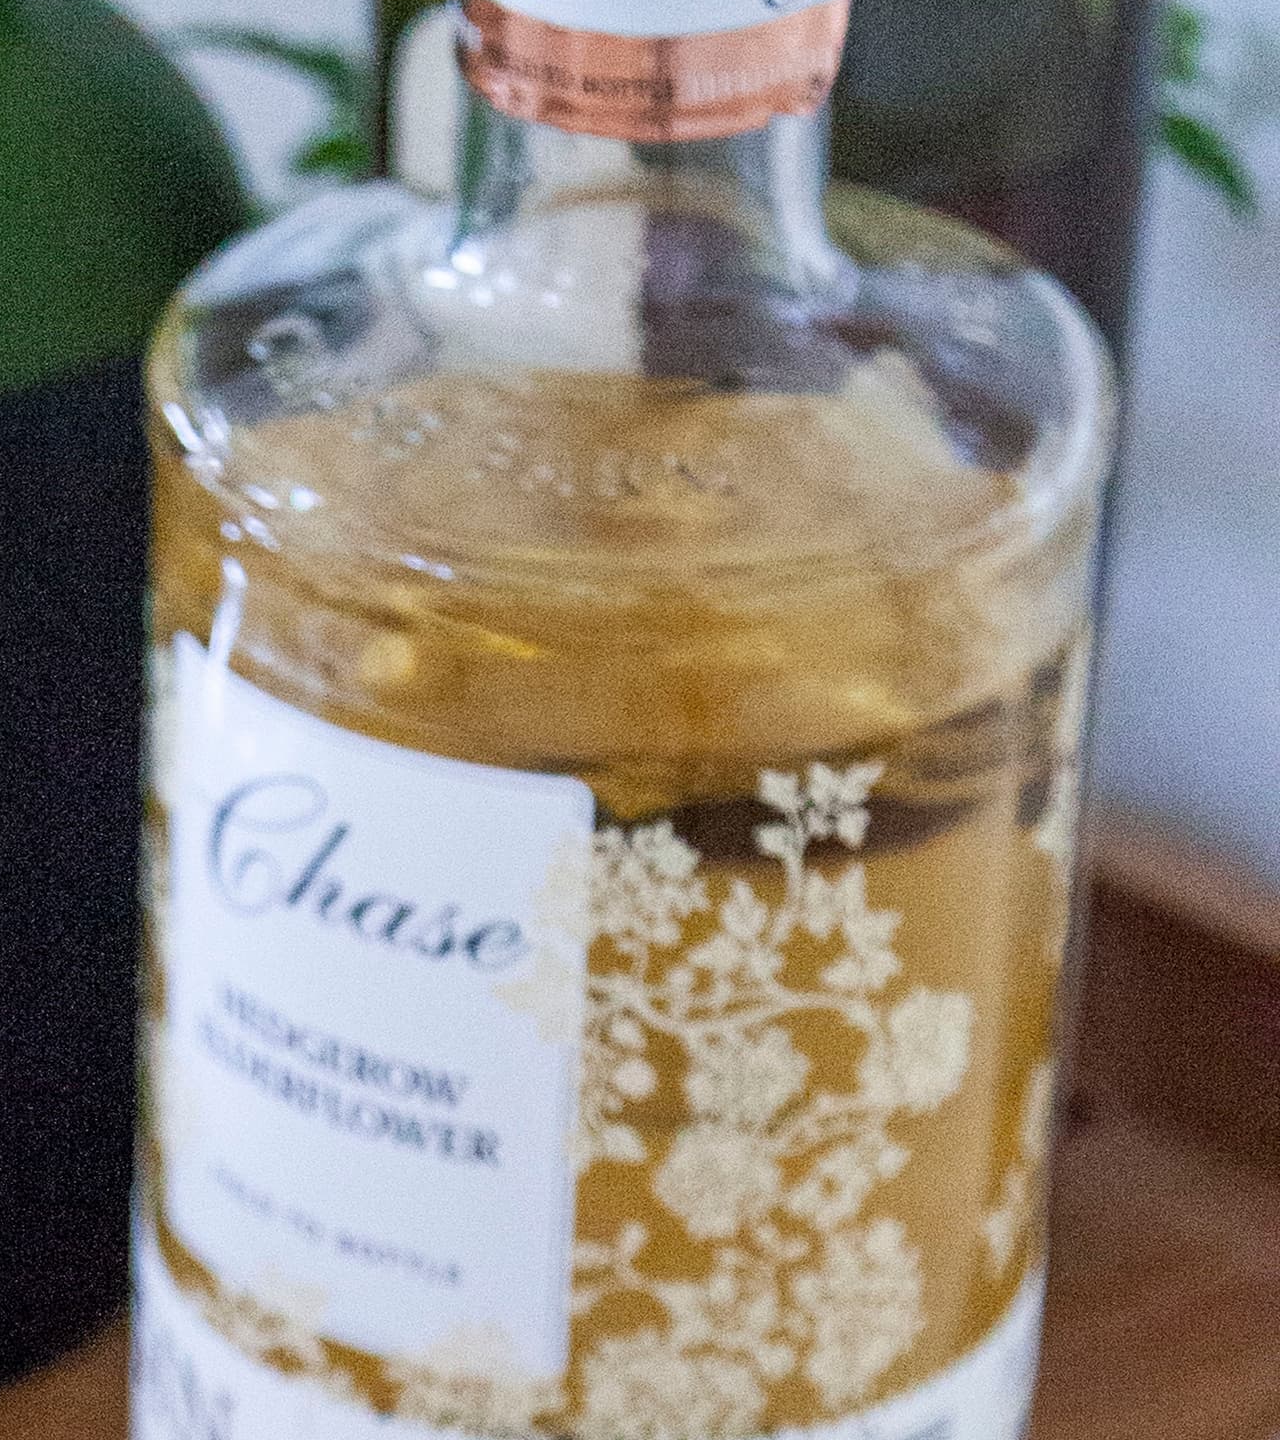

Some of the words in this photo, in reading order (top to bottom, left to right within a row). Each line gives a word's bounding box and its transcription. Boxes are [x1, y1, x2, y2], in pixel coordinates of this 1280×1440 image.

[205, 772, 530, 972] Chase
[198, 1015, 502, 1168] ELDERFLOWER
[219, 981, 469, 1107] HEDGEROW
